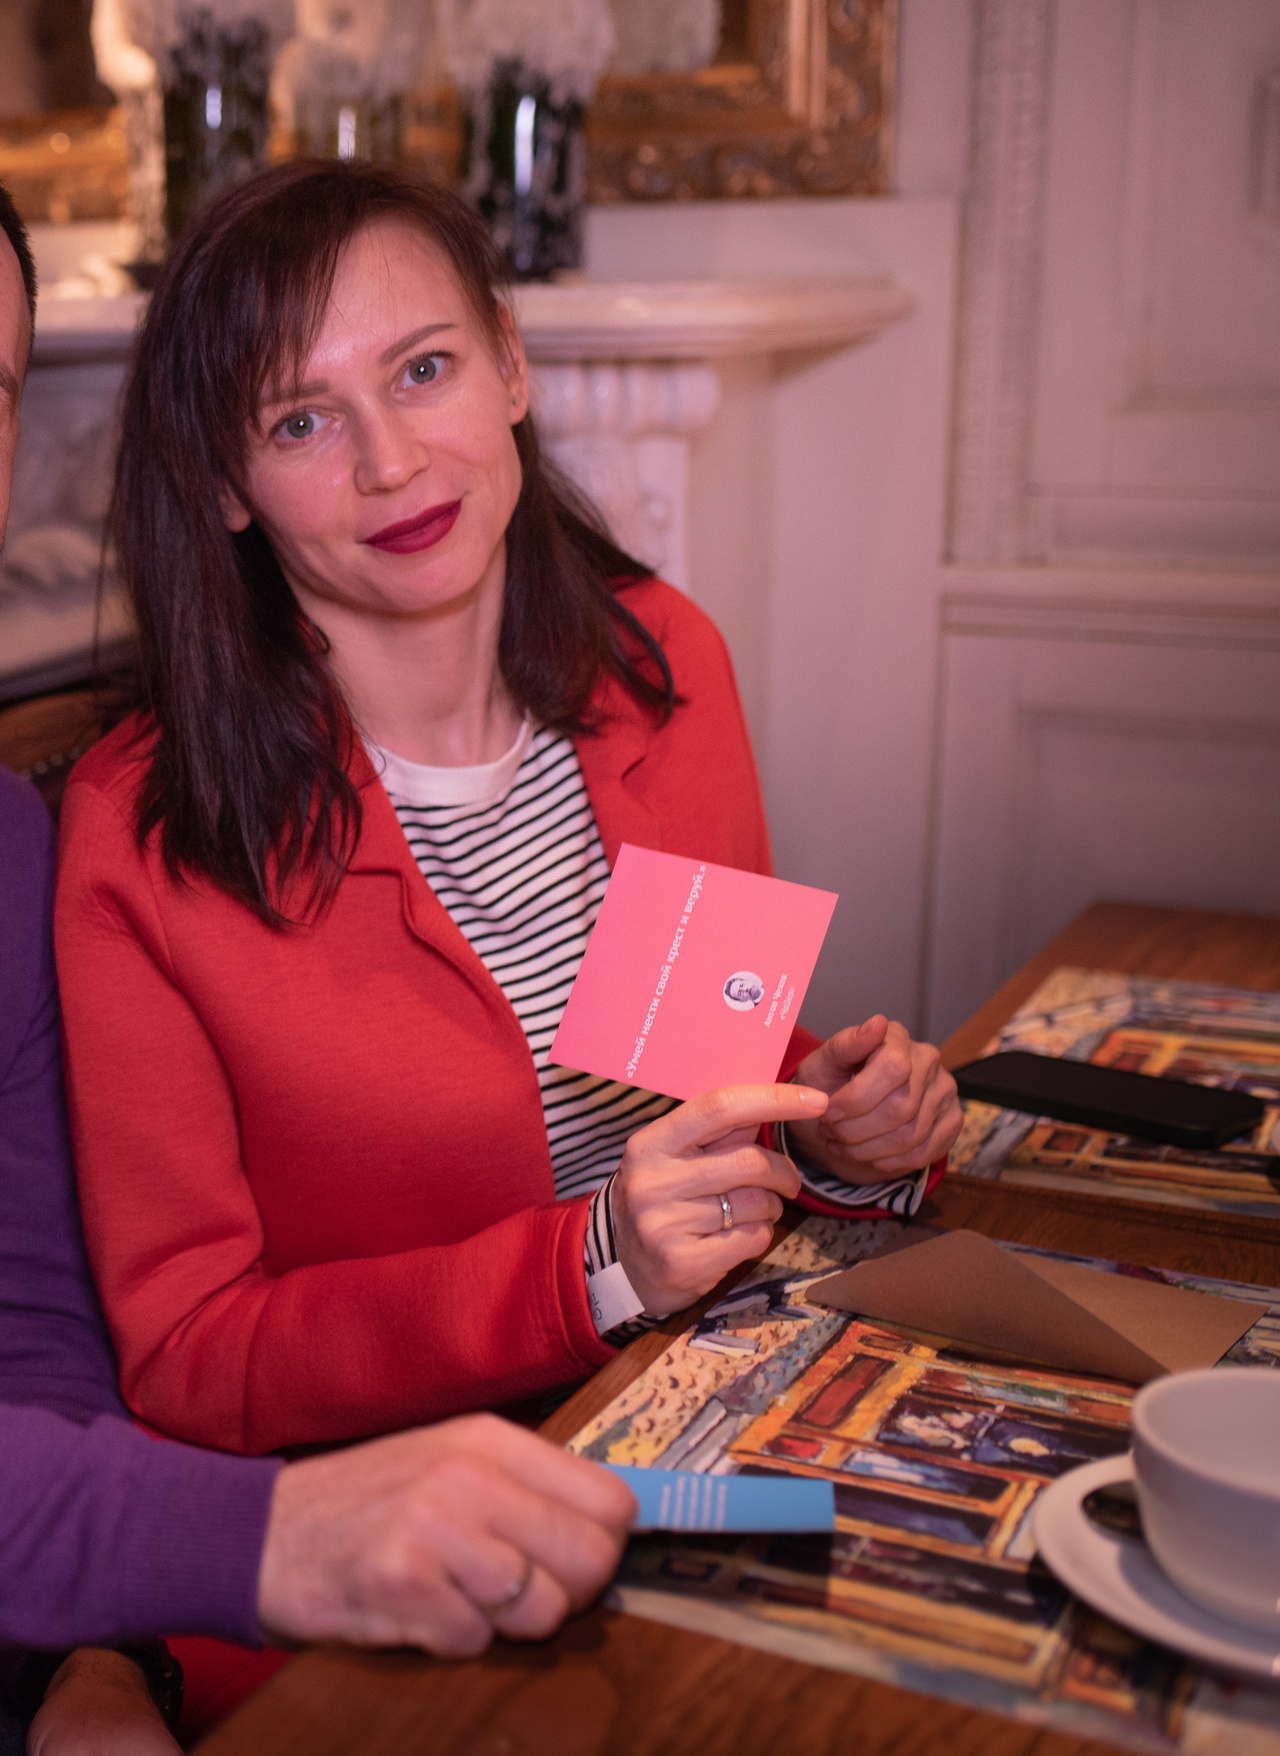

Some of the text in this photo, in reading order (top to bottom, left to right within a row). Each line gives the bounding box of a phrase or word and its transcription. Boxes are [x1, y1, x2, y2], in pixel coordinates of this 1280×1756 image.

[626, 1037, 647, 1078] «Умей
[641, 998, 661, 1035] нести
[656, 965, 672, 996] свой
[667, 926, 685, 963] крест
[680, 915, 689, 925] и
[764, 974, 787, 1028] Антон Чехов
